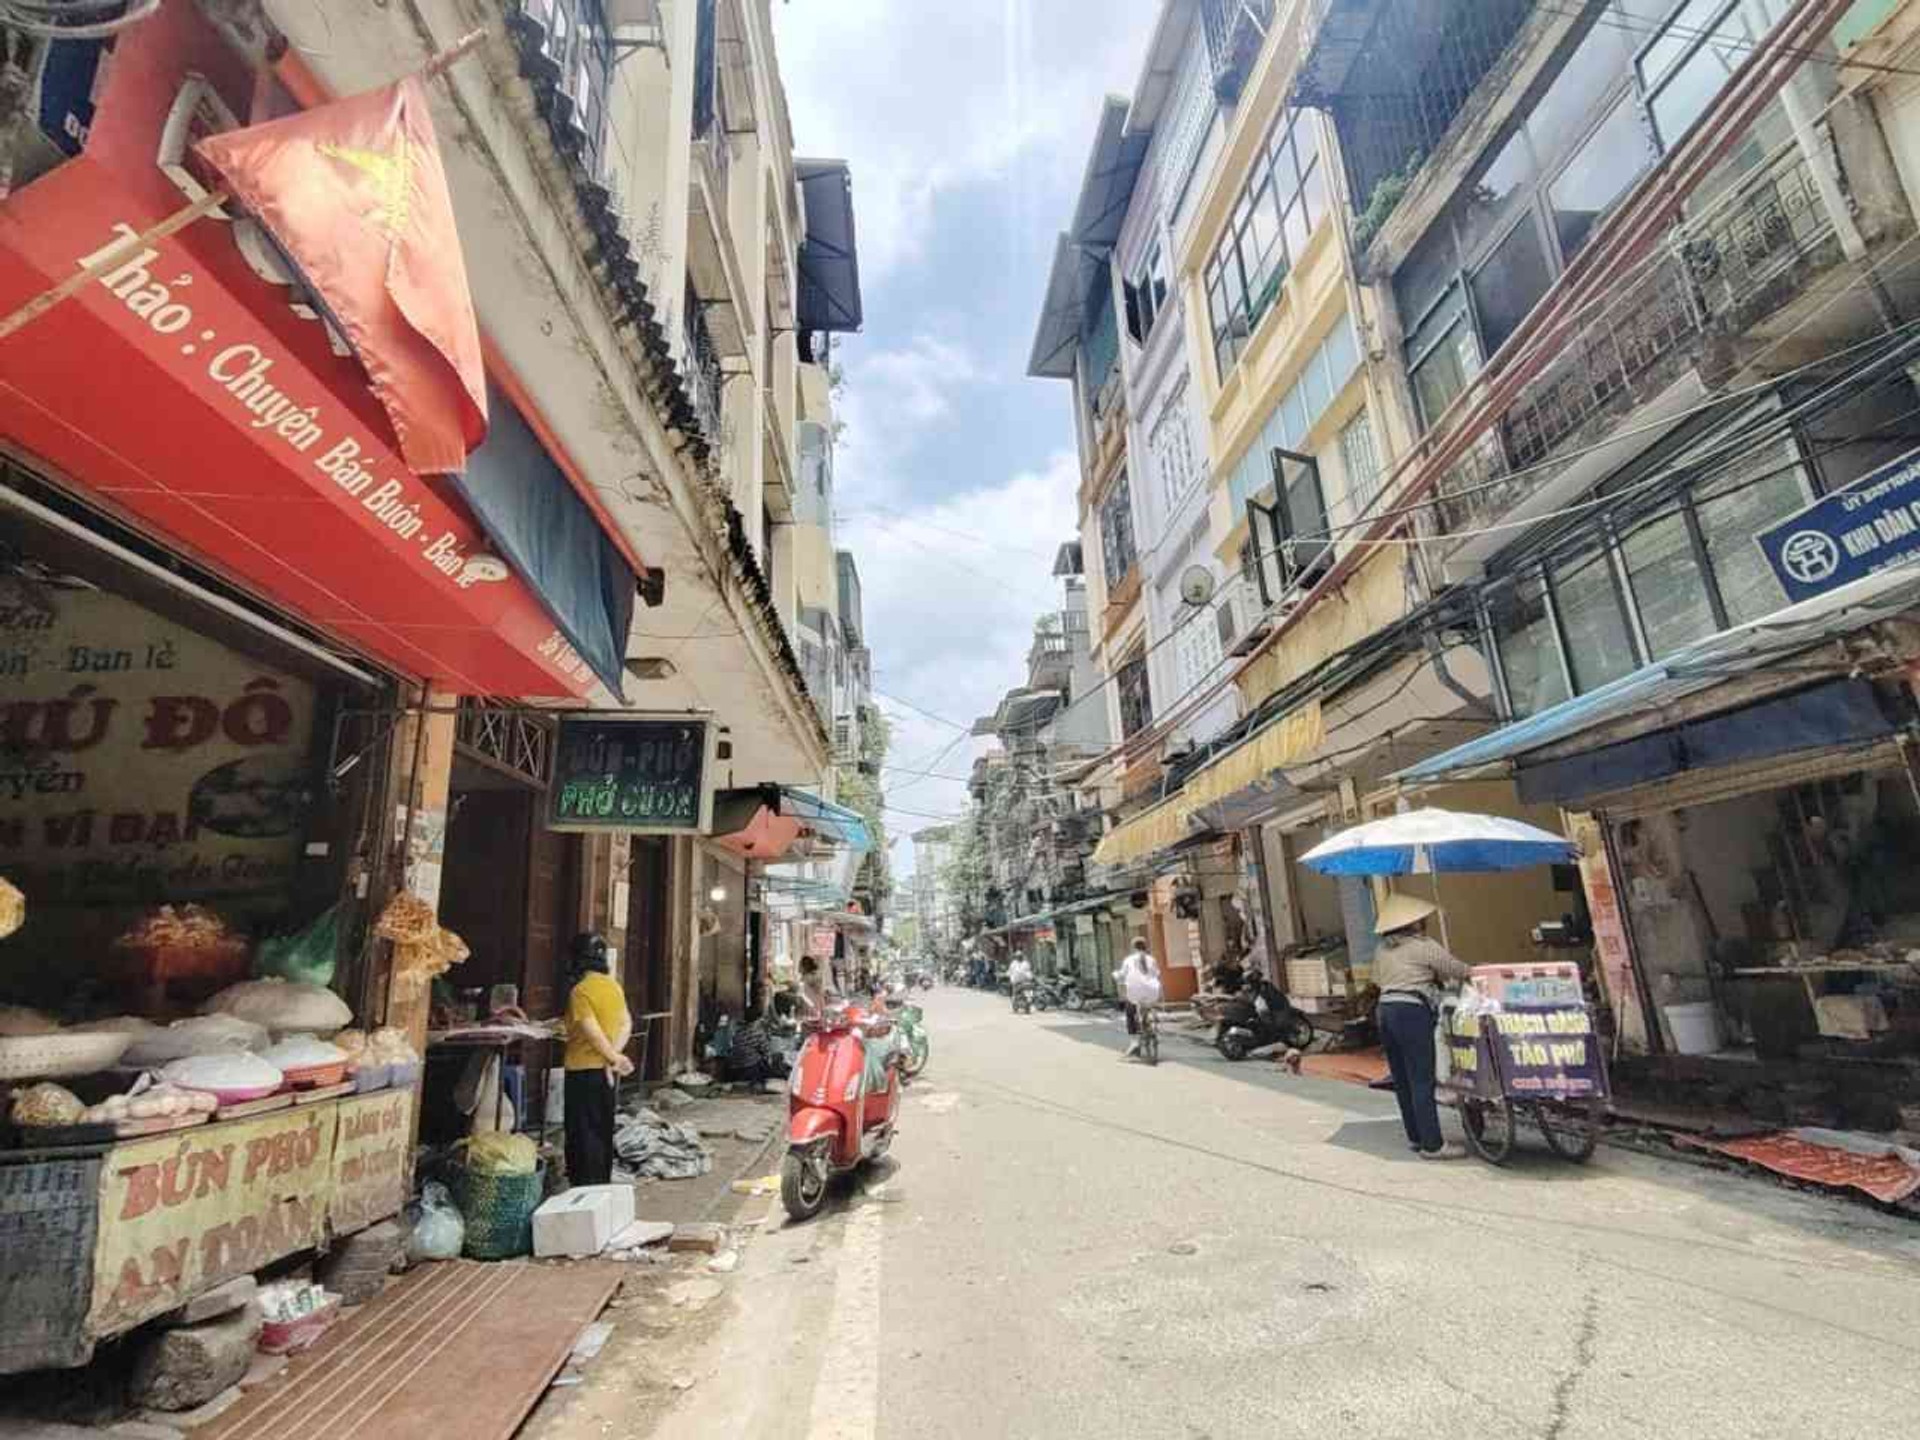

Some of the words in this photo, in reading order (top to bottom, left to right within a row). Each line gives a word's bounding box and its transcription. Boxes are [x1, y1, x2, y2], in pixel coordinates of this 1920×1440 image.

[77, 222, 193, 334] Thảo
[208, 343, 323, 452] Chuyên
[314, 436, 374, 496] Bán
[361, 477, 424, 540] Buôn
[1840, 524, 1880, 558] KHU
[141, 677, 292, 749] ĐÔ
[118, 1140, 235, 1222] BÚN
